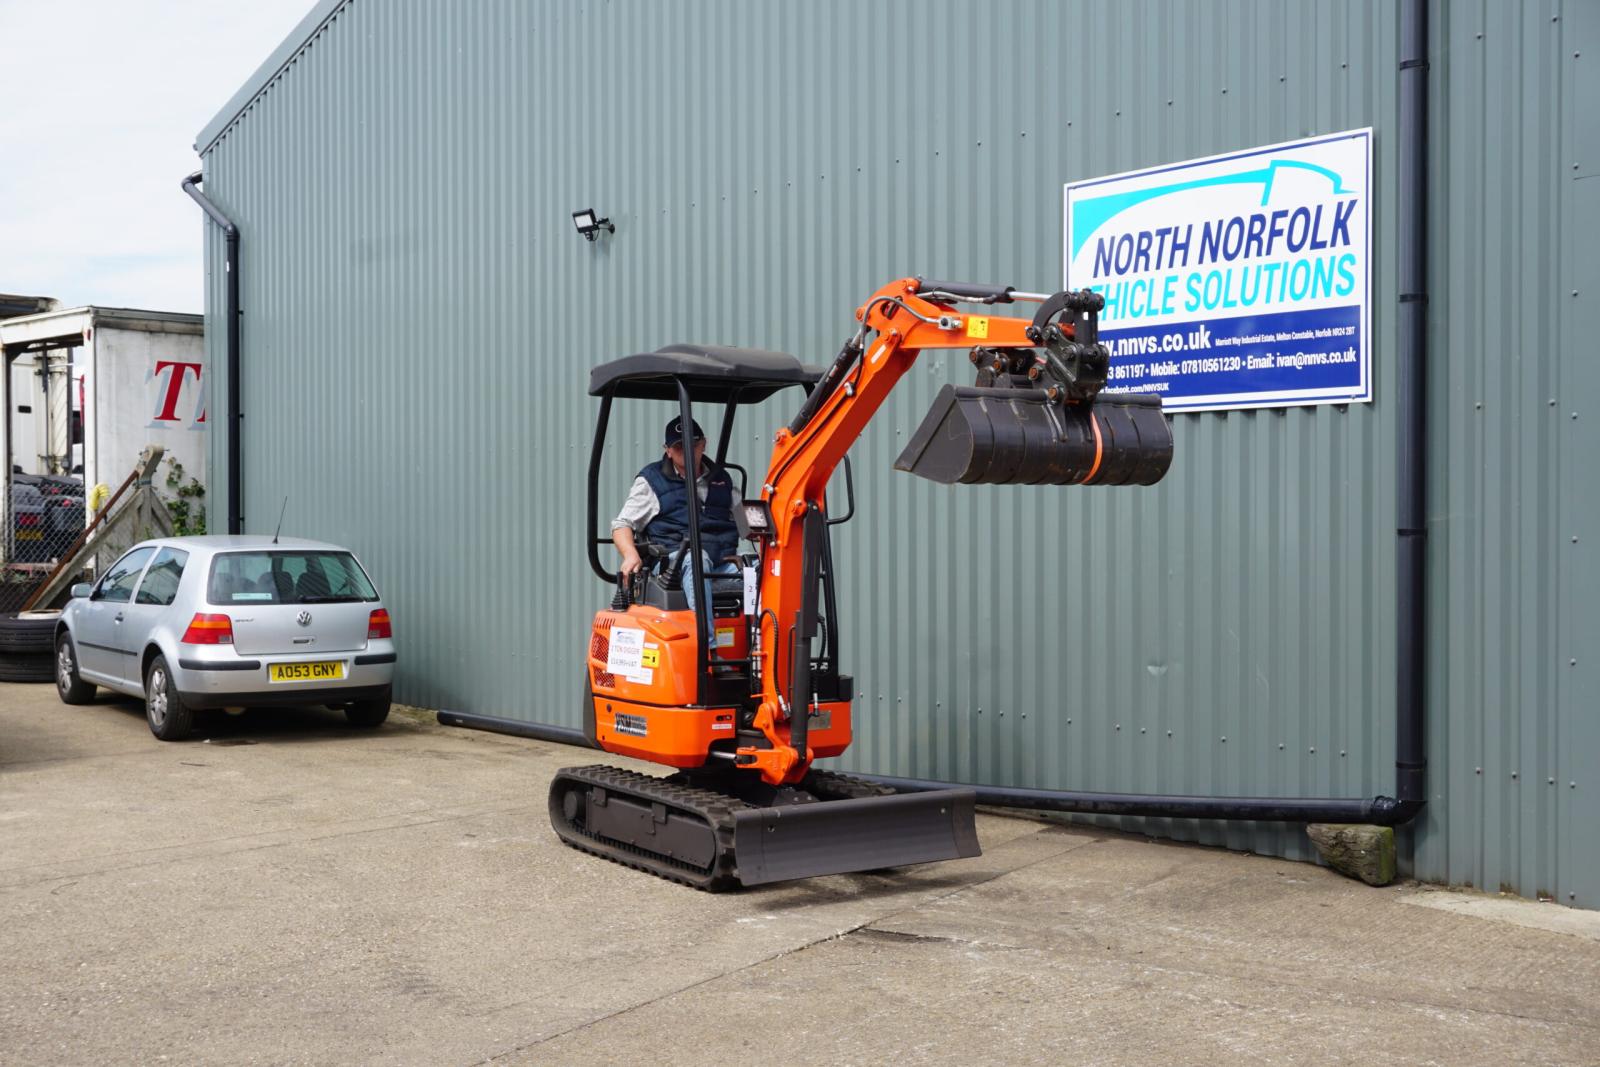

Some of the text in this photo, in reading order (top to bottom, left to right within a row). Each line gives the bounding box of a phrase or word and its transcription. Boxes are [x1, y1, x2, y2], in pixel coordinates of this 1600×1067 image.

[1093, 199, 1358, 278] NORTH NORFOLK
[1073, 253, 1357, 321] HICLE SOLUTIONS
[1315, 328, 1332, 338] Norfolk
[1115, 364, 1145, 379] 861197
[1151, 361, 1180, 376] Mobile:
[1182, 356, 1240, 374] 07810561230
[1247, 353, 1275, 370] Email:
[1277, 347, 1356, 370] ivan@nnvs.co.uk
[277, 664, 336, 678] AO53 GNY
